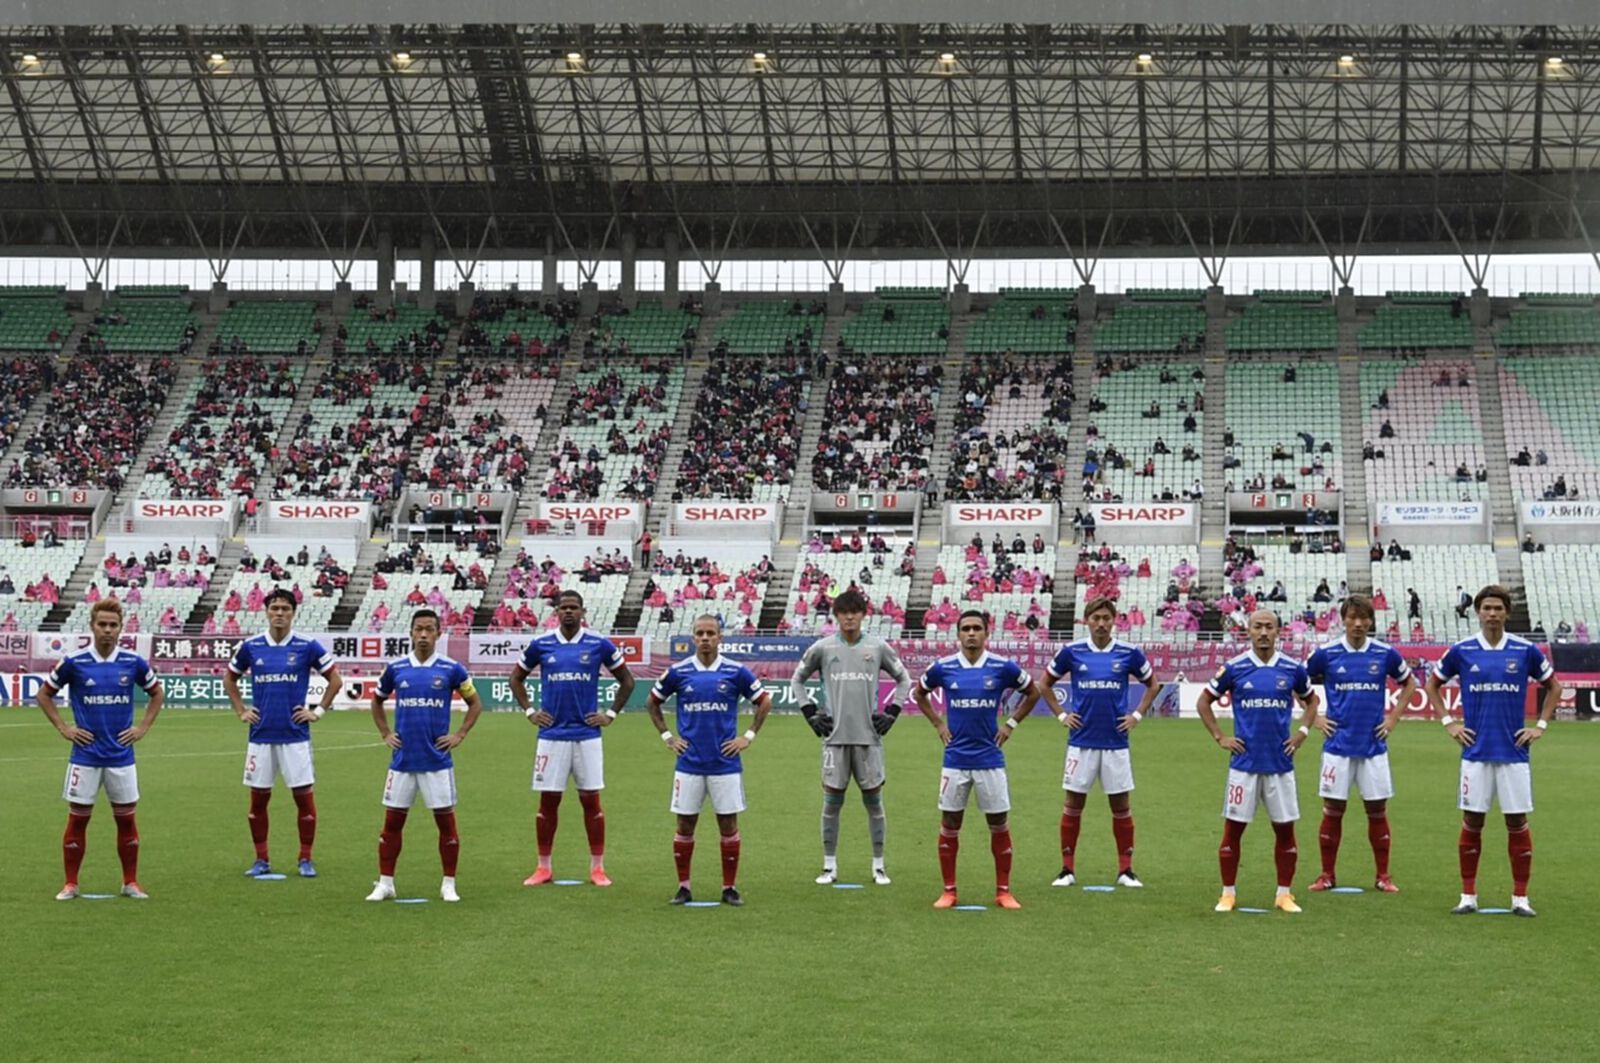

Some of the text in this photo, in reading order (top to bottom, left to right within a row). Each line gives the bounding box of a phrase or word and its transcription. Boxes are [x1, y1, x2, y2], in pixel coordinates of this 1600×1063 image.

[26, 491, 37, 502] G
[431, 494, 441, 504] G
[837, 496, 846, 506] G
[1254, 495, 1263, 506] F
[143, 505, 223, 518] SHARP
[279, 505, 359, 518] SHARP
[549, 507, 631, 520] SHARP
[685, 508, 767, 520] SHARP
[960, 508, 1042, 521] SHARP
[1101, 508, 1185, 521] SHARP
[1548, 505, 1600, 517] 大阪体育
[154, 639, 192, 658] 丸橋
[333, 637, 413, 657] 朝日新
[717, 643, 754, 654] SPECT
[254, 673, 298, 684] NISSAN
[547, 672, 592, 683] NISSAN
[830, 672, 874, 682] NISSAN
[159, 678, 253, 699] 治安田生
[308, 686, 324, 695] 20
[1078, 680, 1121, 690] NISSAN
[1335, 682, 1380, 692] NISSAN
[1469, 683, 1519, 693] NISSAN
[84, 695, 129, 705] NISSAN
[739, 685, 821, 704] テルズ
[399, 698, 444, 708] NISSAN
[684, 702, 728, 712] NISSAN
[951, 698, 996, 709] NISSAN
[1241, 698, 1287, 709] NISSAN
[245, 755, 256, 772] 5
[71, 767, 80, 787] 5
[1322, 765, 1336, 784] 44
[1229, 784, 1244, 805] 38
